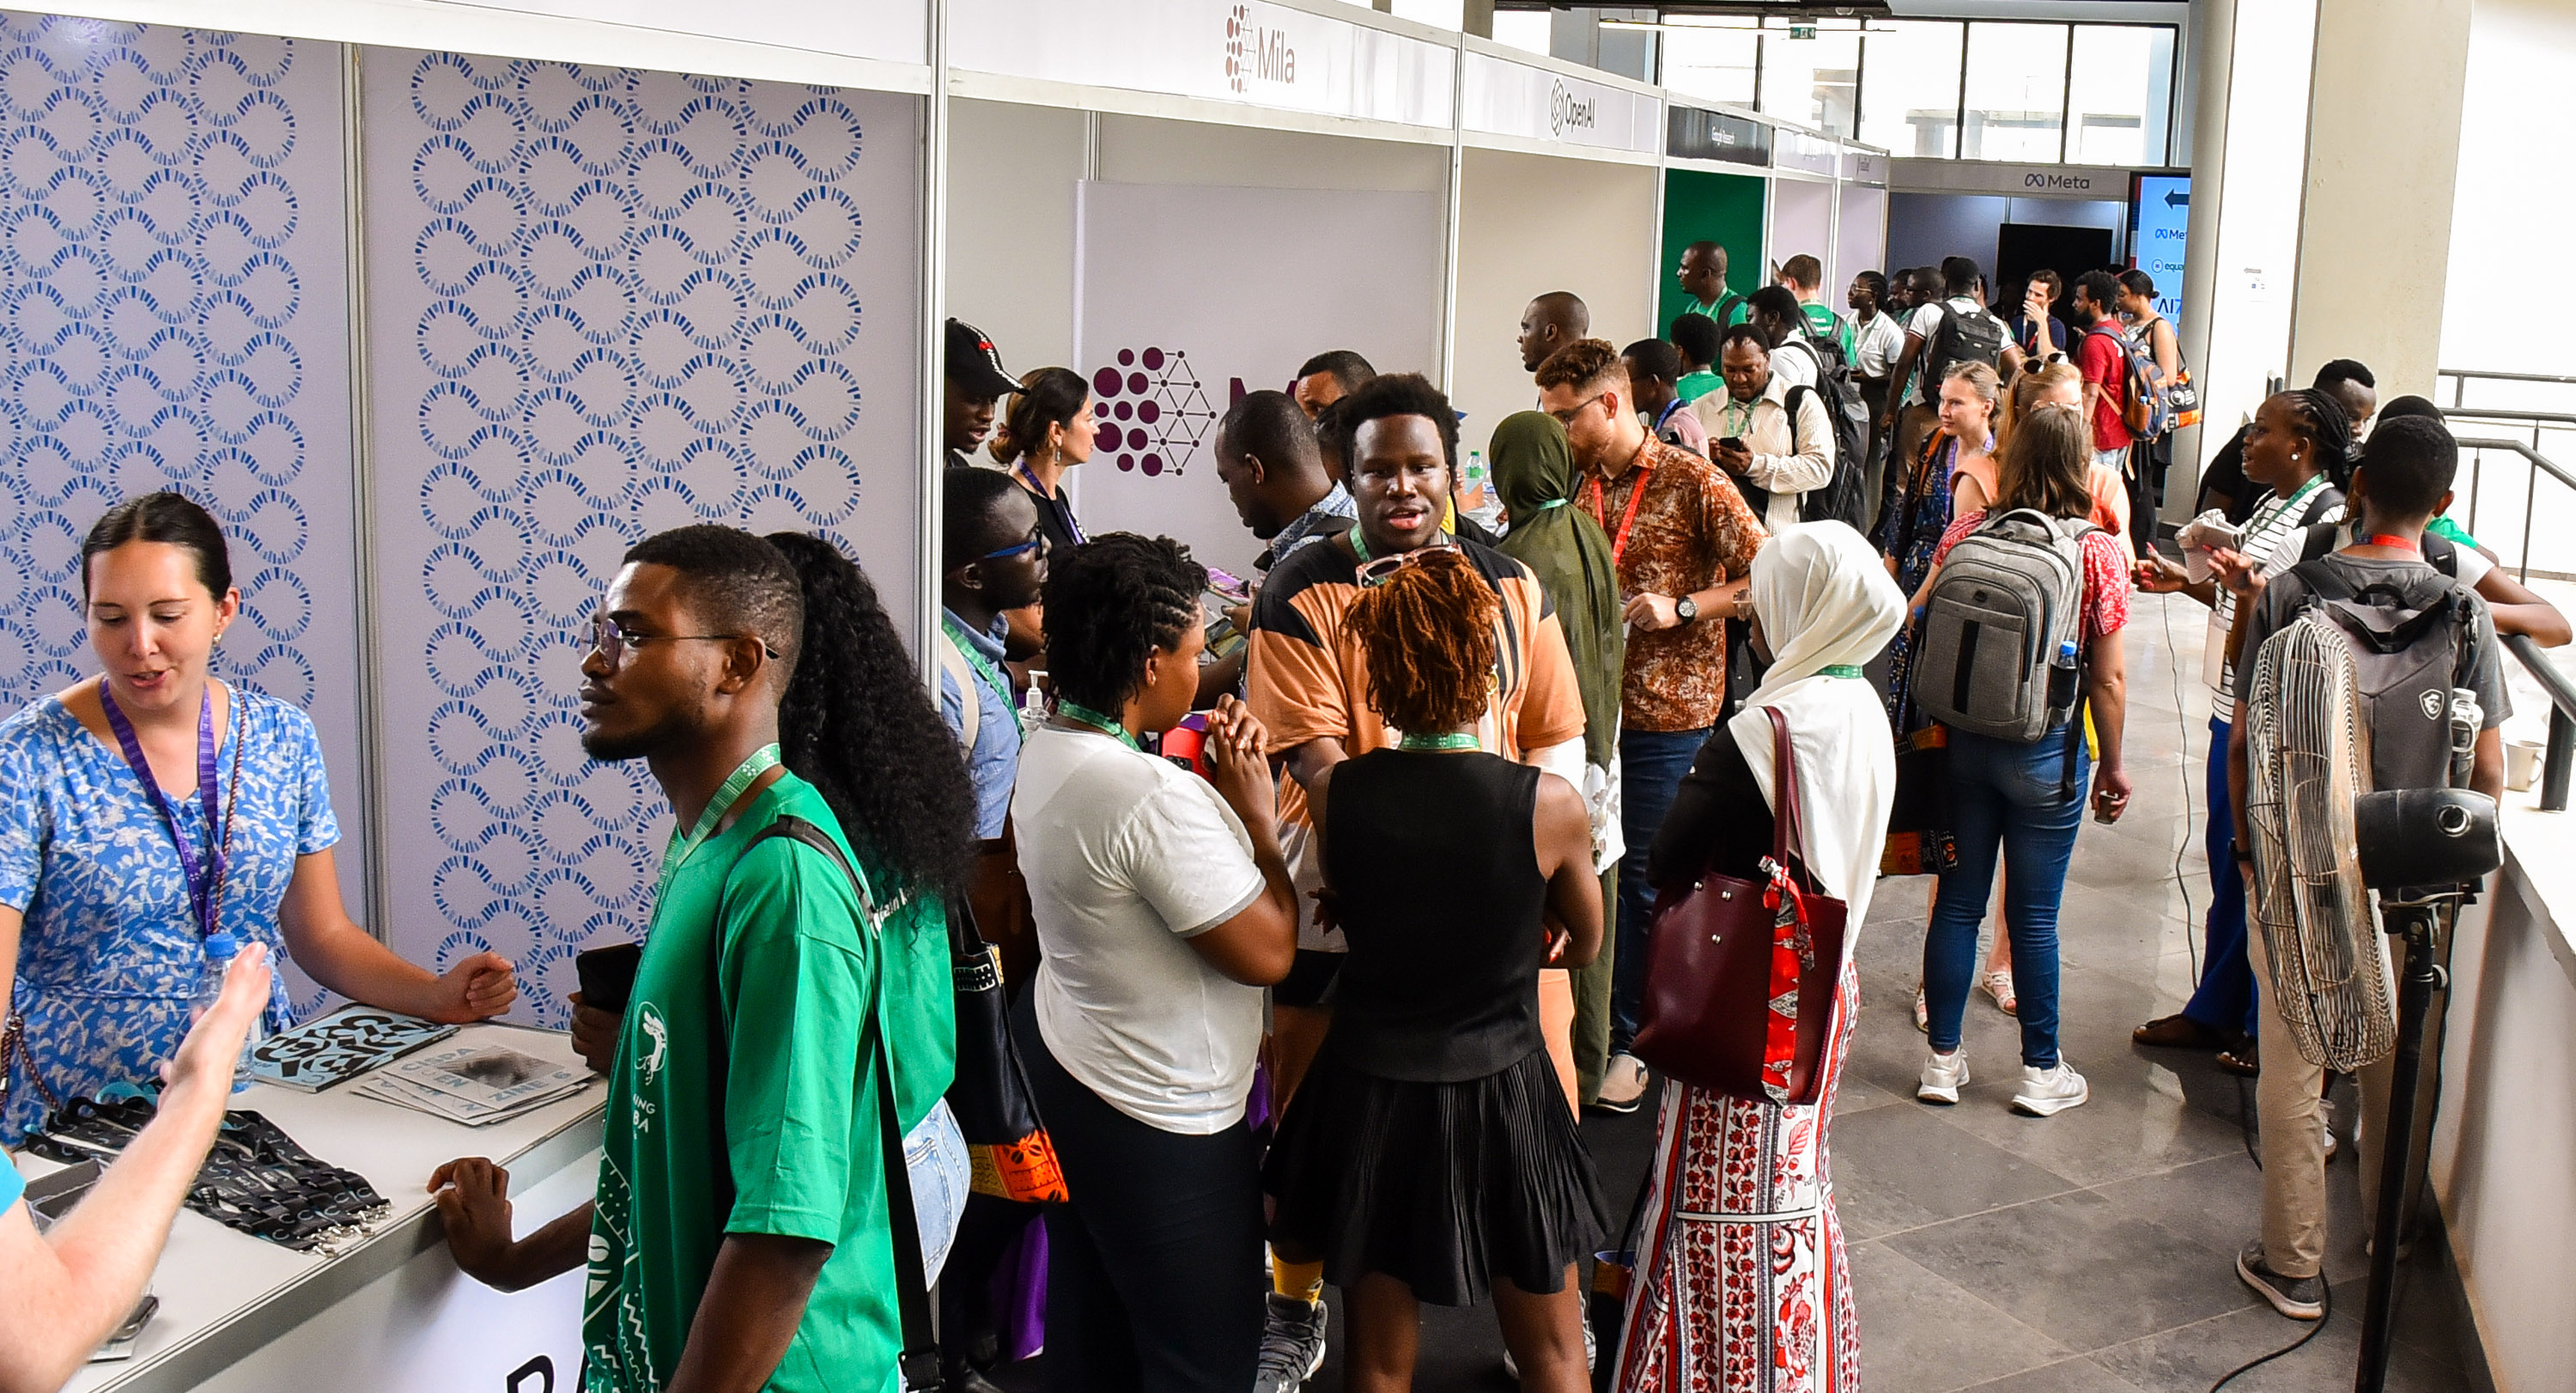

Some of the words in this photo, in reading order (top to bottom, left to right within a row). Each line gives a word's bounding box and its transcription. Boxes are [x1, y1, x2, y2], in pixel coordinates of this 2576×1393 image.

[1258, 26, 1295, 84] Mila
[1565, 92, 1595, 133] OpenAI
[2047, 174, 2090, 189] Meta
[2169, 230, 2188, 240] Me
[489, 1080, 549, 1102] ZINE
